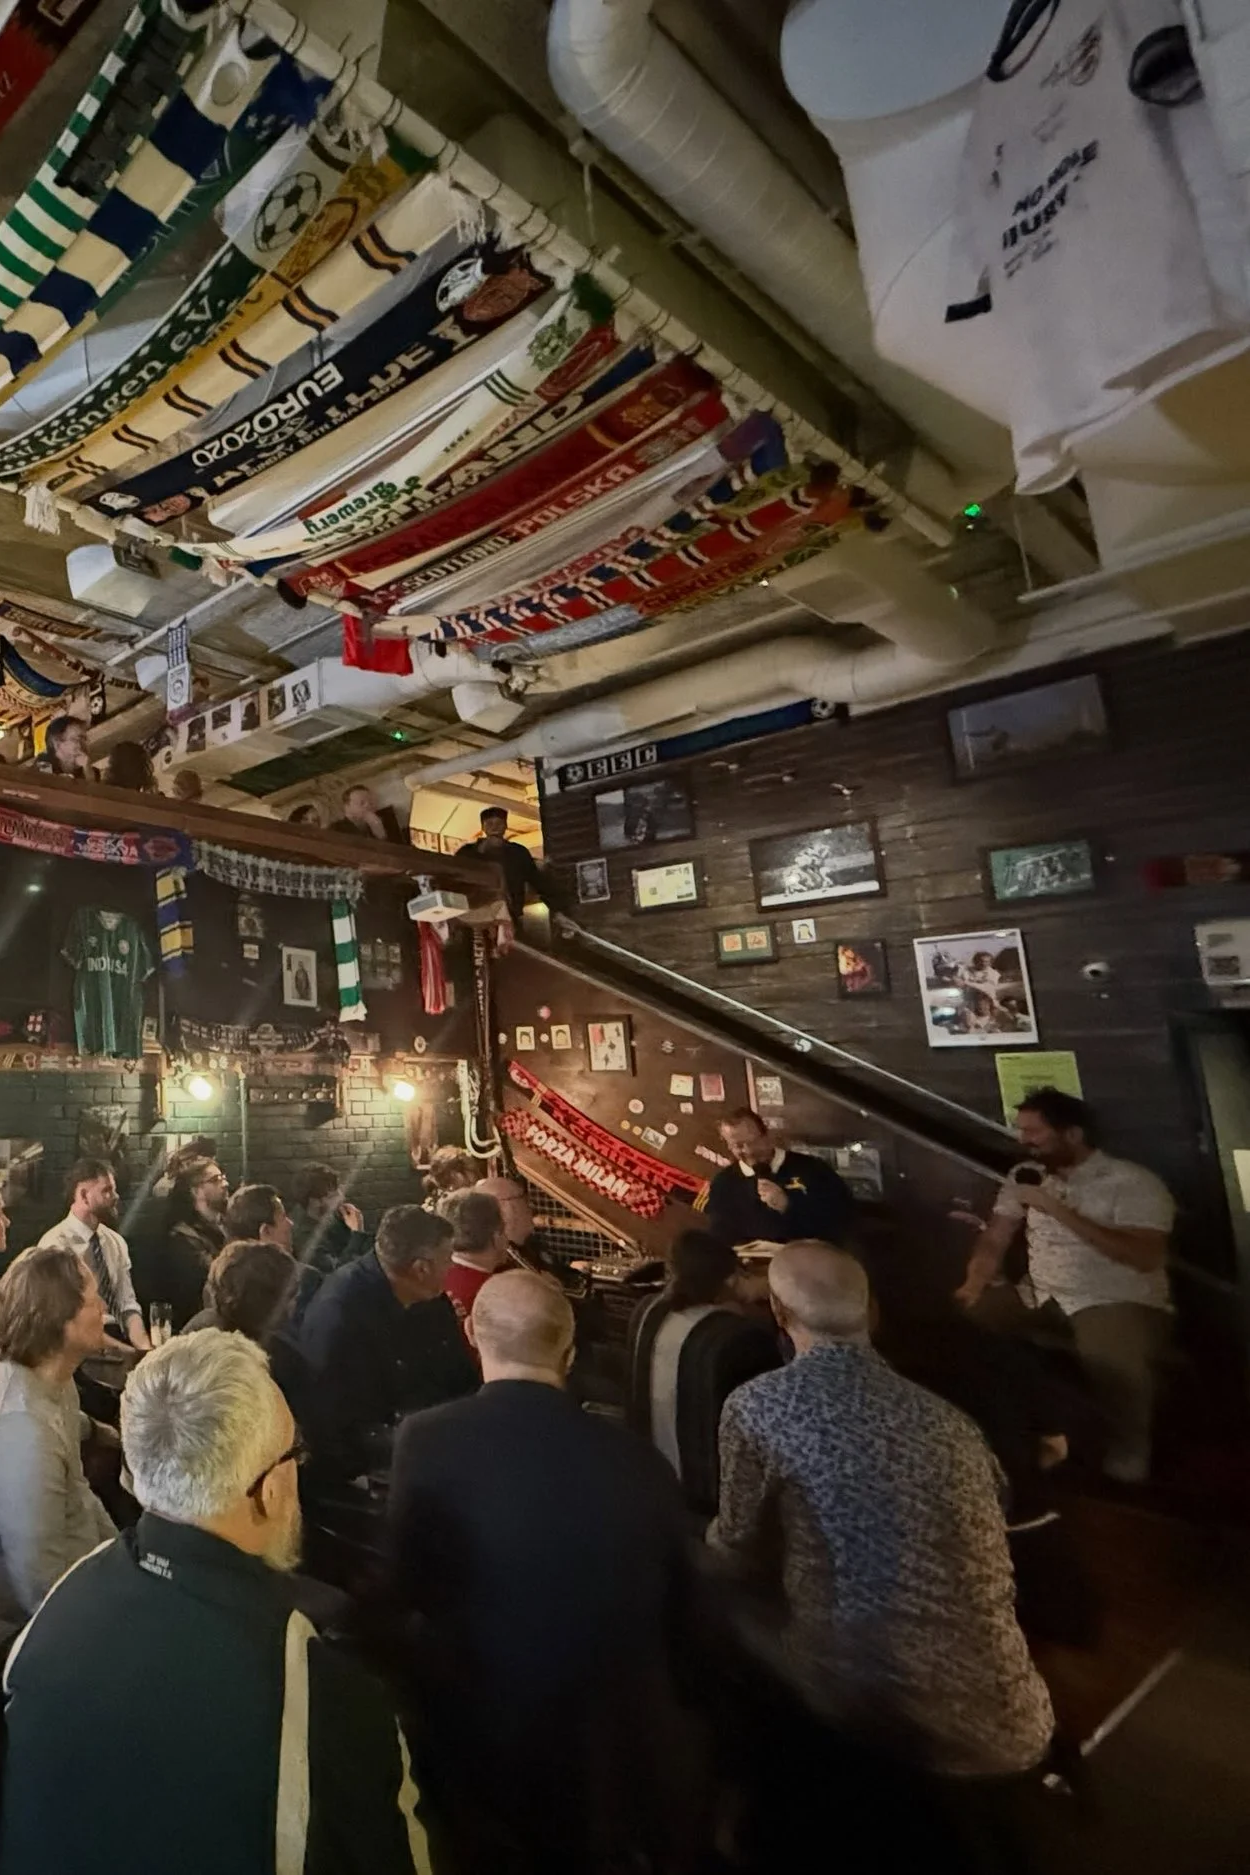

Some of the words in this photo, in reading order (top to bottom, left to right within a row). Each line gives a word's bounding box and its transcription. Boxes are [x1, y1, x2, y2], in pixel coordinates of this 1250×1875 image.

[39, 358, 169, 452] Köngen
[168, 296, 228, 352] e.V.
[191, 360, 345, 468] EURO2020
[246, 444, 296, 477] SUNDAY
[330, 402, 367, 428] MAY
[301, 480, 398, 537] Brewery
[525, 1123, 575, 1166] FORZA
[574, 1156, 630, 1198] MILAN
